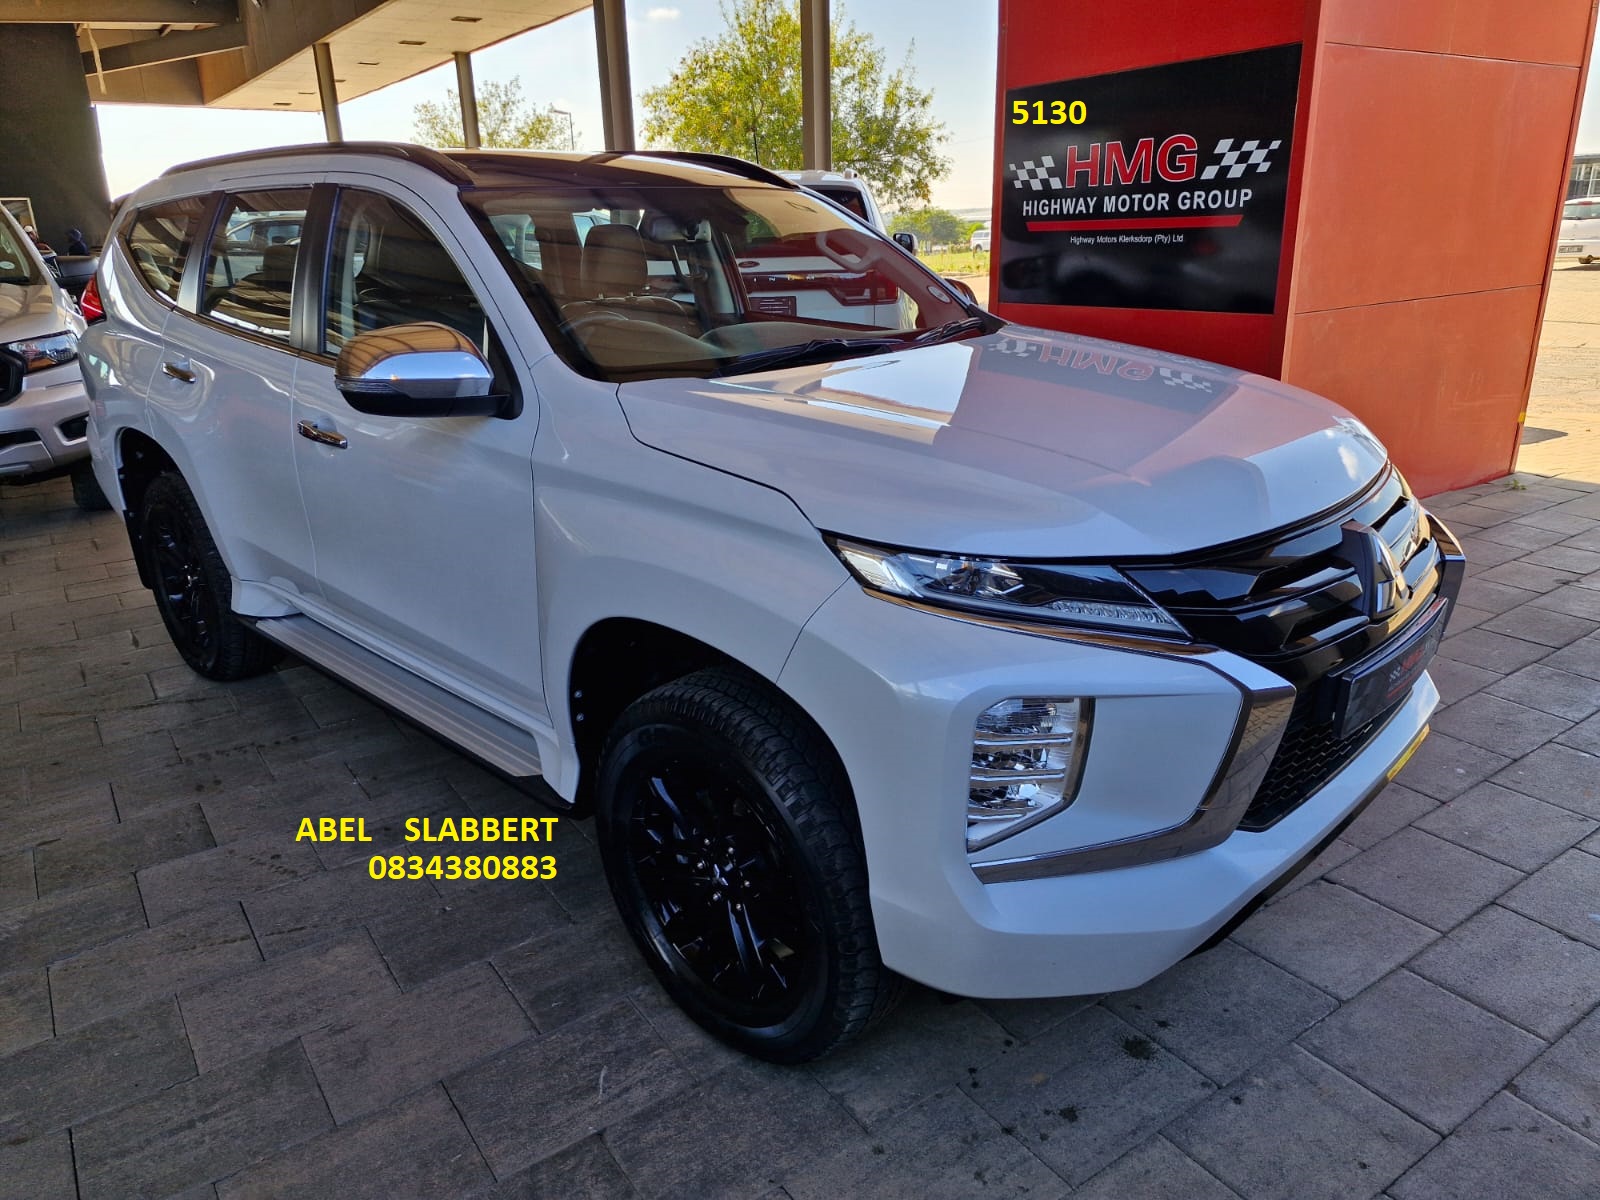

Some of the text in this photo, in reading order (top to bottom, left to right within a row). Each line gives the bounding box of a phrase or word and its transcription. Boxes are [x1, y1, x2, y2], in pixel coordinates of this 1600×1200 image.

[1065, 133, 1198, 188] HMG
[1022, 188, 1253, 217] HIGHWAY MOTOR GROUP
[1070, 236, 1095, 245] Highway
[1097, 235, 1117, 243] Motors
[1119, 234, 1152, 244] Klerksdorp
[1172, 233, 1184, 242] Ltd
